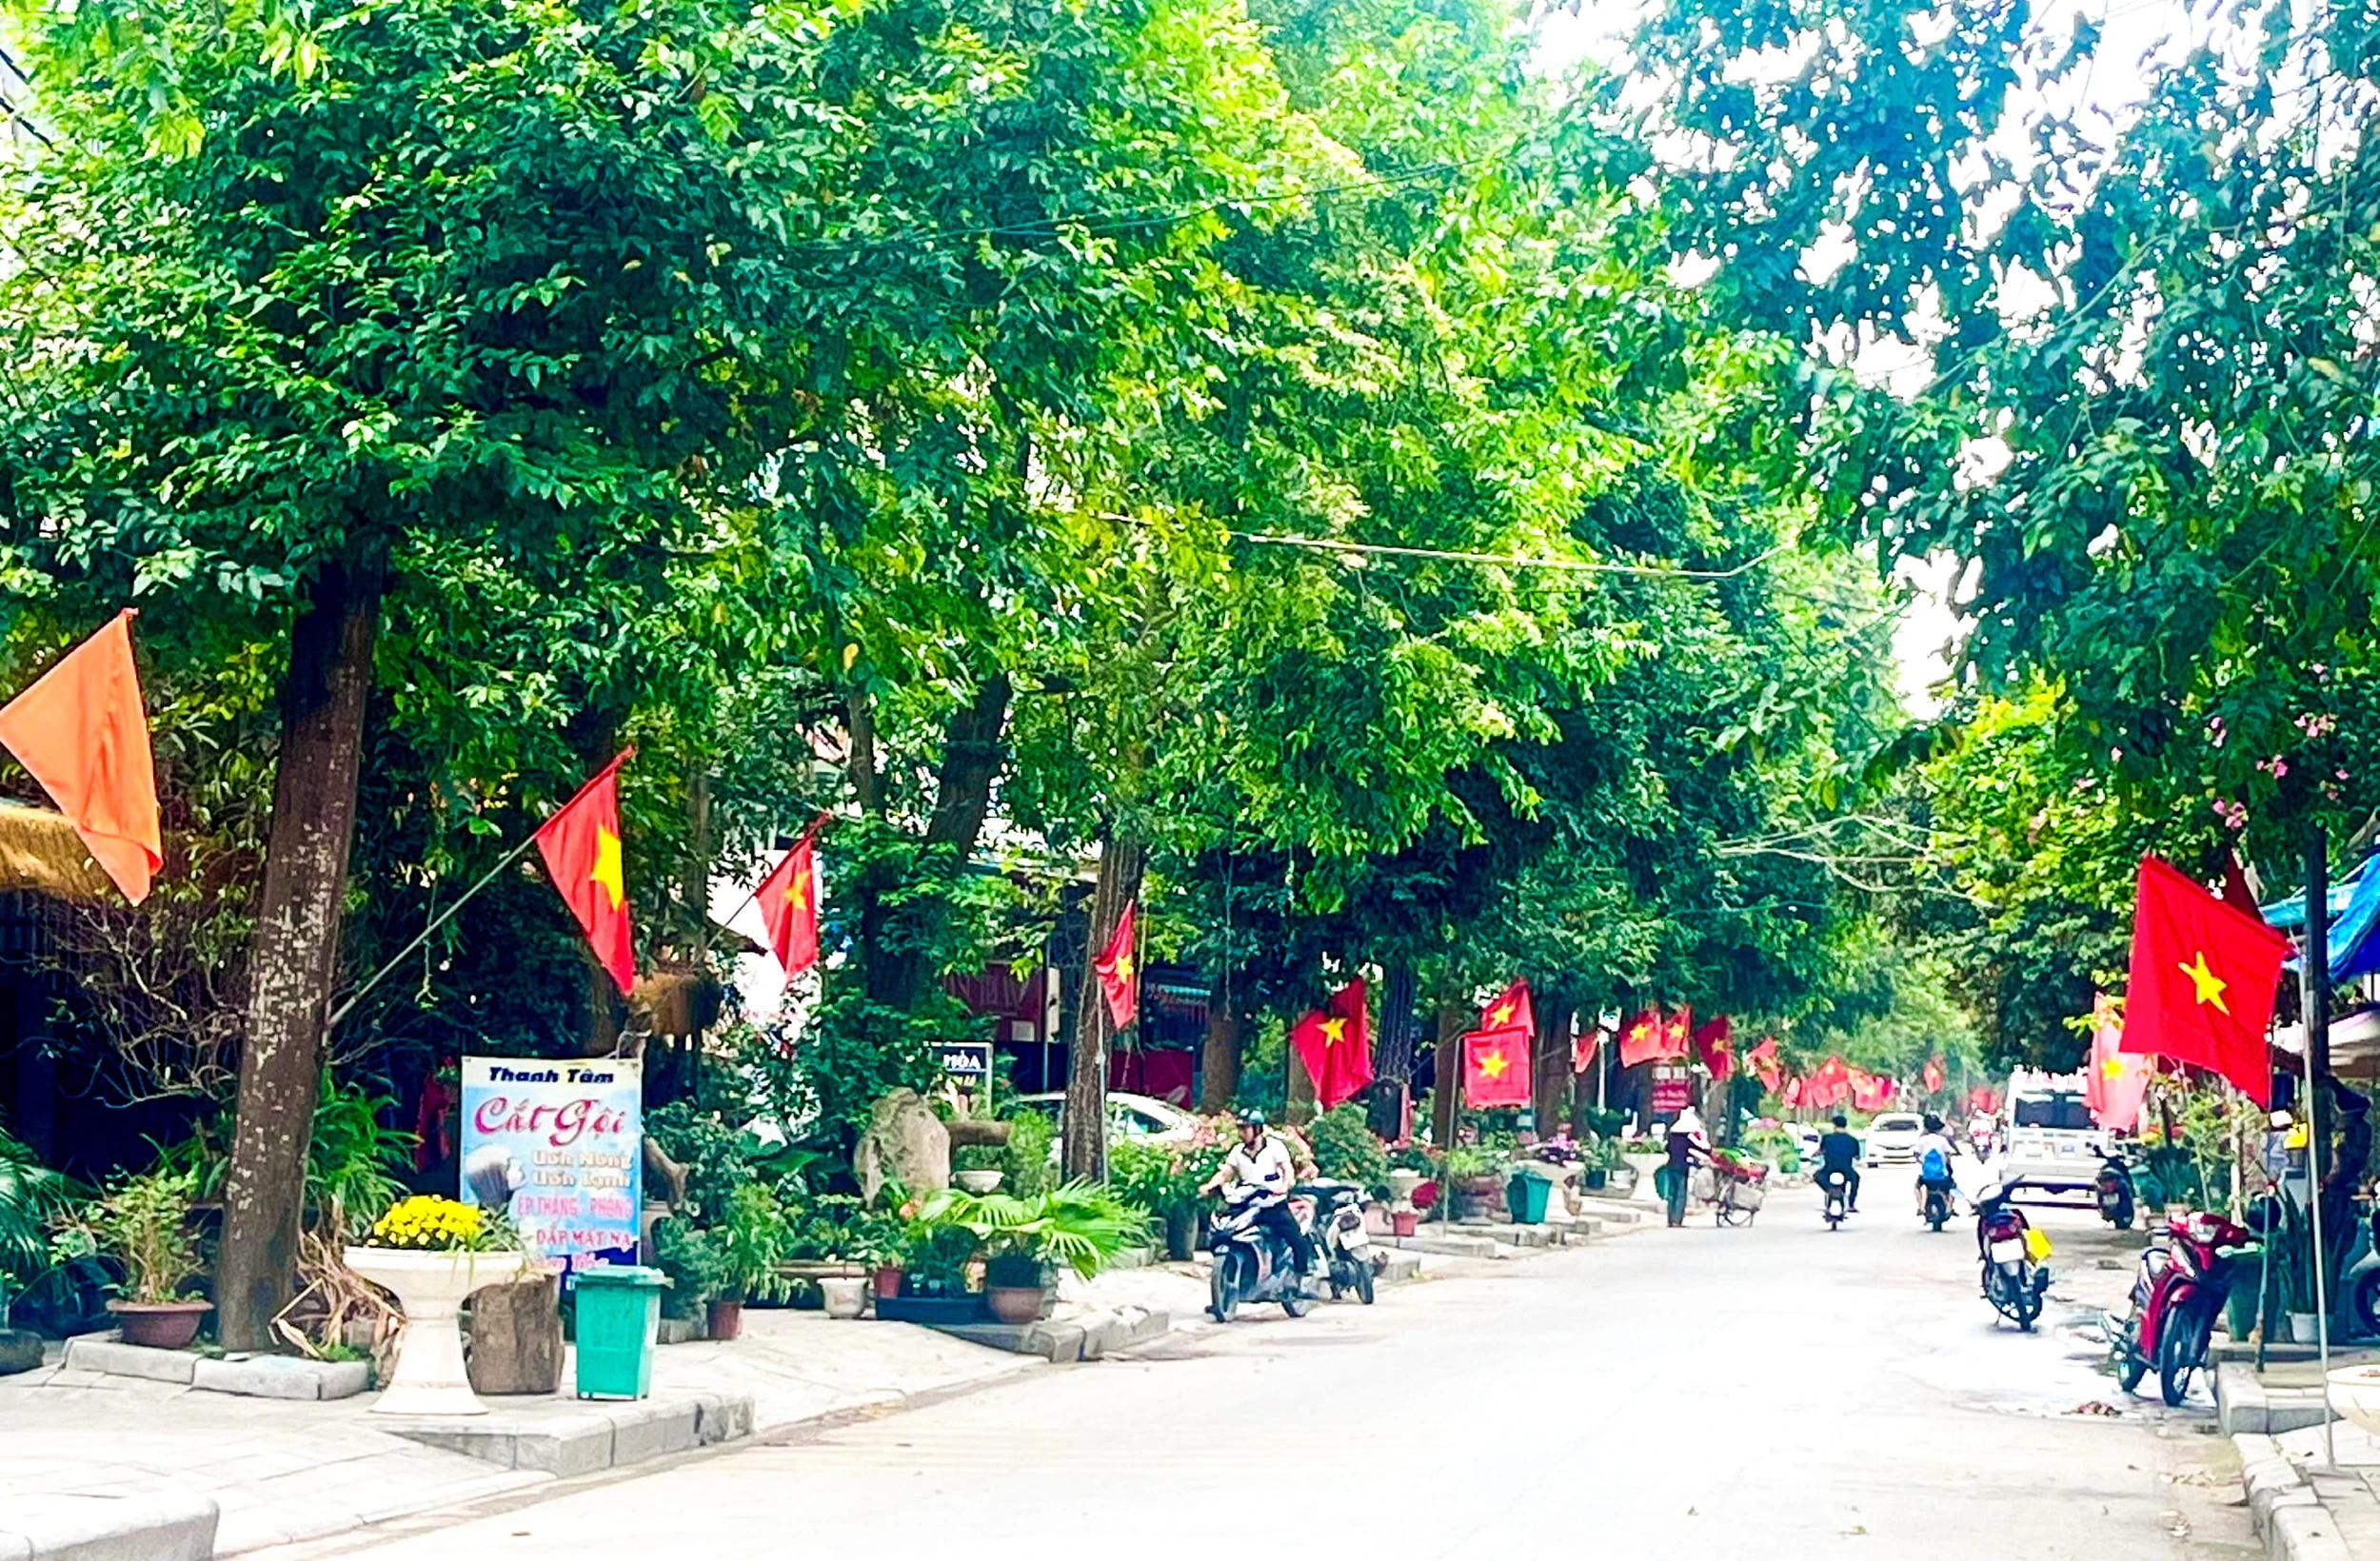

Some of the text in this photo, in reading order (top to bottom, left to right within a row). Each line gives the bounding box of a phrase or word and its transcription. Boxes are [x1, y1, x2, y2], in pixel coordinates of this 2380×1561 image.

[489, 1066, 615, 1083] Thanh Tâm
[474, 1097, 625, 1147] Cắt Gội
